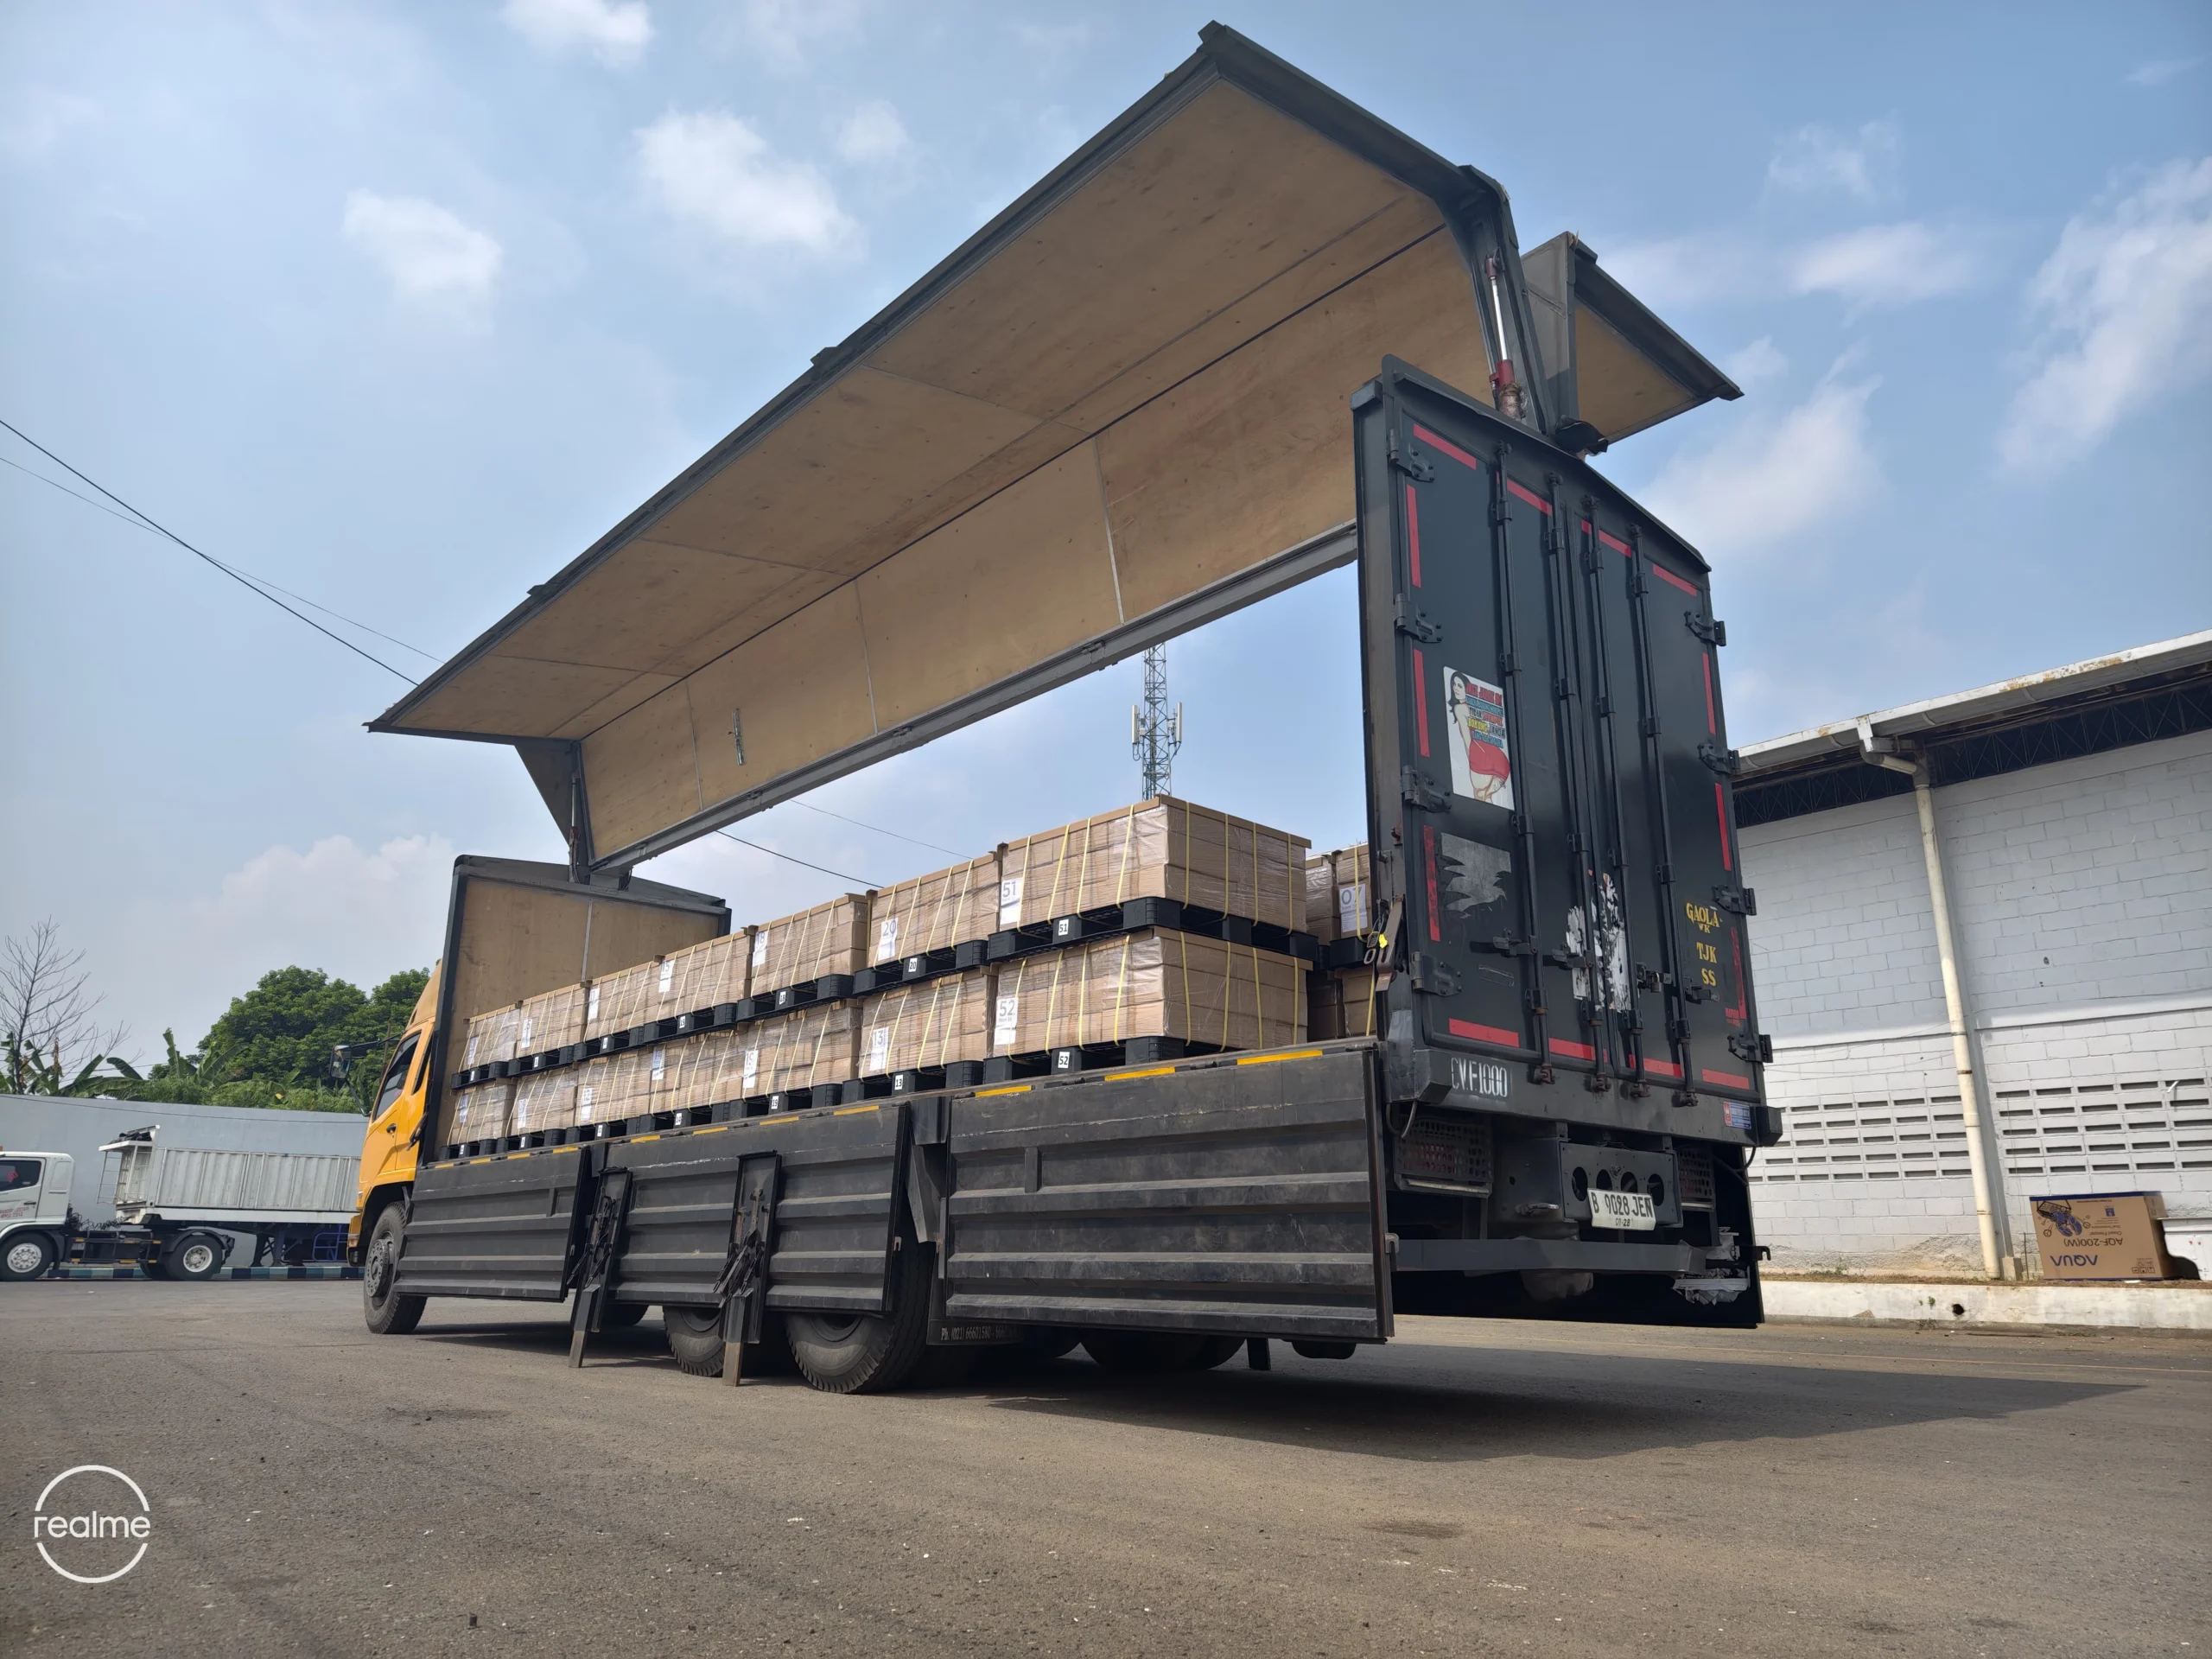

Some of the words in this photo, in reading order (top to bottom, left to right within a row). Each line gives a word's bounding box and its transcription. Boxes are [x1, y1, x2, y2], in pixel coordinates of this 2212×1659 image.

[1002, 881, 1016, 898] 51
[1686, 902, 1720, 928] GAOLA
[883, 920, 897, 936] 20
[1058, 923, 1067, 933] 51
[1696, 941, 1718, 963] TJK
[909, 961, 917, 969] 20
[1701, 967, 1717, 987] SS
[999, 1000, 1014, 1017] 52
[874, 1030, 883, 1046] 13
[1059, 1056, 1068, 1065] 52
[1591, 1192, 1599, 1213] B
[1605, 1193, 1630, 1216] 9028
[1631, 1196, 1653, 1217] JEN
[2063, 1237, 2123, 1247] AQF-200(W)
[2050, 1255, 2098, 1266] AQUA
